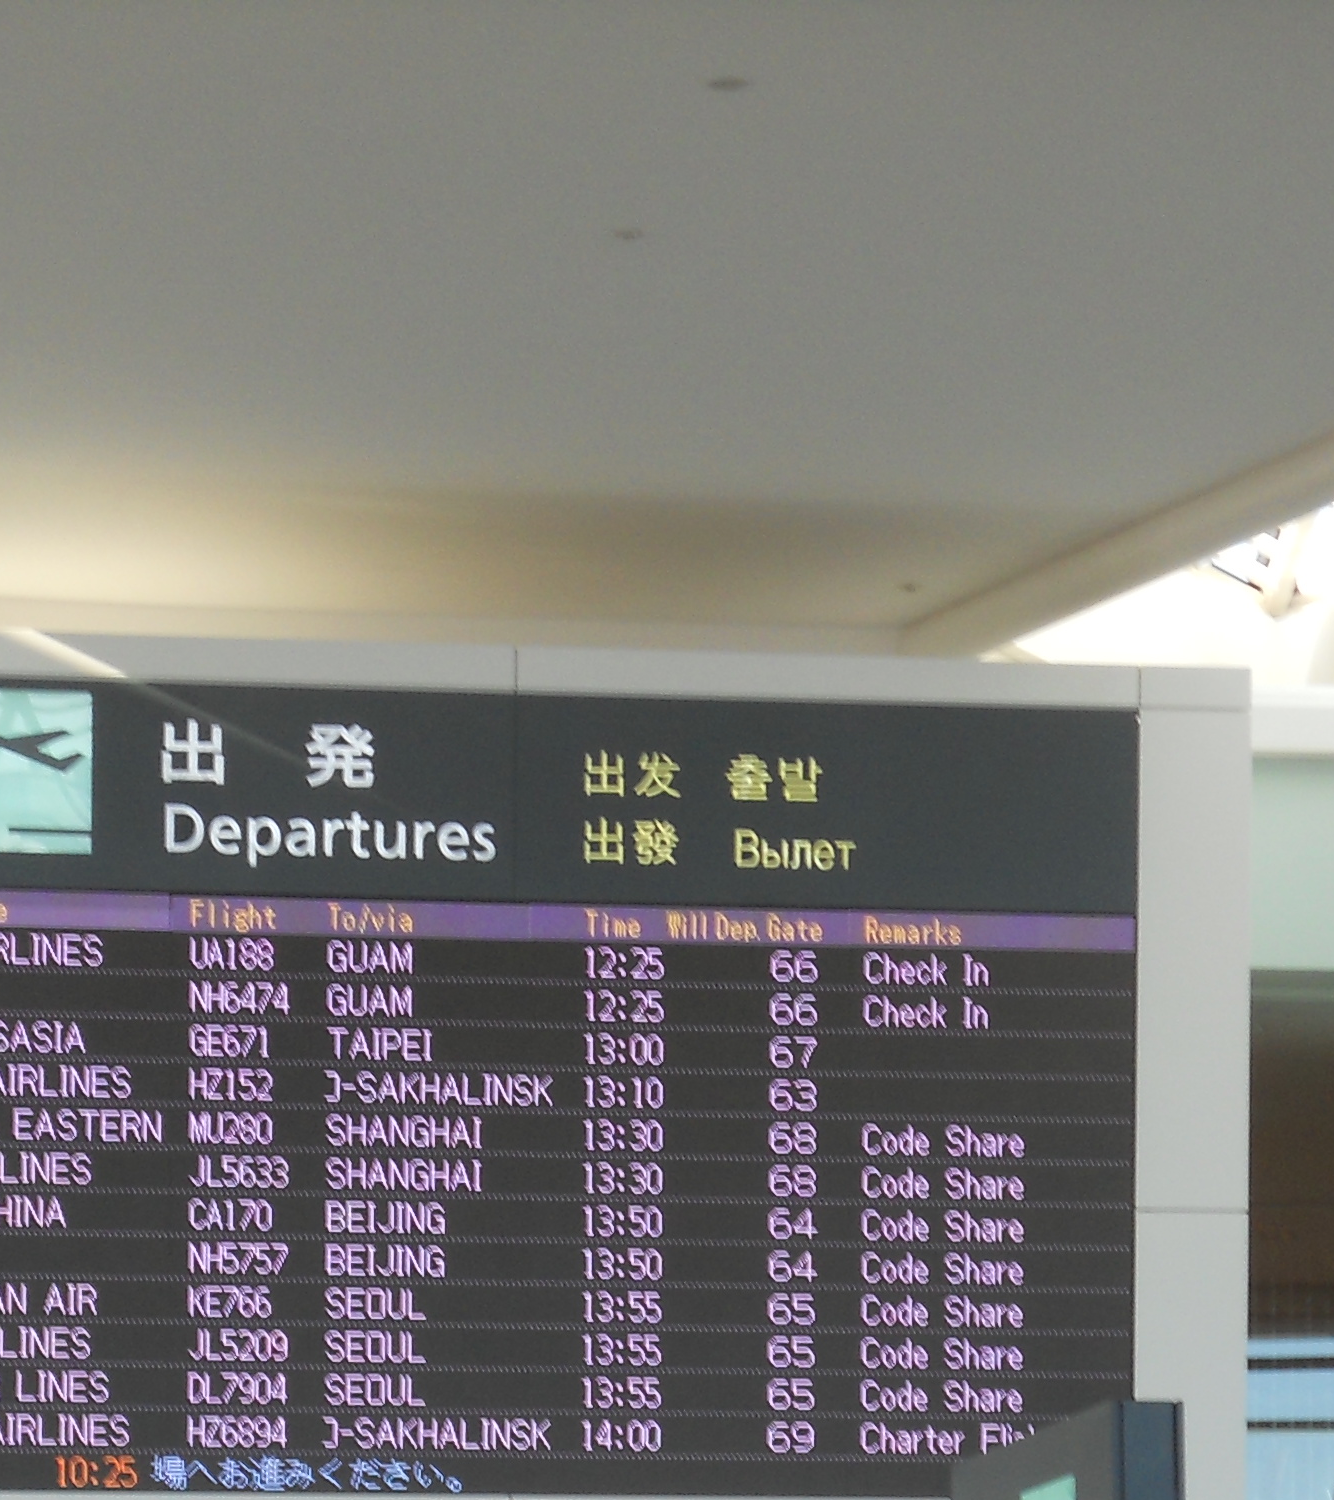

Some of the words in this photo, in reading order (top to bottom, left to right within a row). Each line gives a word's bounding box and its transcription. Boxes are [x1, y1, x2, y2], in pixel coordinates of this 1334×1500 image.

[584, 750, 681, 798] 出发
[725, 753, 823, 802] 출발
[163, 801, 497, 868] Departures
[584, 816, 679, 866] 出發
[734, 828, 857, 871] Вылет
[189, 898, 277, 933] Flight
[583, 908, 641, 940] Time
[767, 914, 824, 944] Gate
[863, 916, 962, 946] Remarks
[325, 939, 414, 974] GUAM
[583, 945, 666, 981] 12:25
[769, 949, 819, 984] 66
[863, 951, 948, 987] Check
[962, 953, 991, 987] In
[188, 979, 290, 1015] NH6474
[325, 983, 414, 1018] GUAM
[583, 989, 666, 1024] 12:25
[769, 992, 819, 1028] 66
[863, 994, 948, 1030] Check
[962, 996, 991, 1030] In
[188, 1022, 269, 1059] GE671
[327, 1026, 433, 1062] TAIPEI
[583, 1032, 665, 1067] 13:00
[768, 1035, 819, 1070] 67
[188, 1066, 274, 1102] HZ152
[583, 1075, 665, 1110] 13:10
[768, 1078, 818, 1113] 63
[12, 1107, 163, 1143] EASTERN
[325, 1113, 482, 1149] SHANGHAI
[582, 1118, 664, 1153] 13:30
[768, 1121, 818, 1156] 68
[861, 1122, 930, 1158] Code
[944, 1123, 1026, 1159] Share
[187, 1154, 289, 1190] JL5633
[325, 1156, 482, 1192] SHANGHAI
[582, 1161, 664, 1196] 13:30
[768, 1164, 818, 1199] 68
[861, 1166, 930, 1201] Code
[944, 1166, 1026, 1202] Share
[187, 1197, 274, 1232] CA170
[325, 1199, 446, 1235] BEIJING
[582, 1204, 664, 1239] 13:50
[767, 1206, 818, 1241] 64
[860, 1208, 930, 1243] Code
[944, 1209, 1025, 1244] Share
[187, 1241, 289, 1275] NH5757
[324, 1243, 446, 1278] BEIJING
[582, 1247, 664, 1281] 13:50
[767, 1249, 818, 1284] 64
[860, 1251, 929, 1286] Code
[944, 1251, 1025, 1287] Share
[43, 1282, 98, 1316] AIR
[187, 1284, 273, 1319] KE766
[324, 1286, 427, 1321] SEOUL
[582, 1290, 664, 1324] 13:55
[767, 1292, 817, 1327] 65
[860, 1293, 929, 1328] Code
[944, 1294, 1025, 1329] Share
[187, 1327, 289, 1362] JL5209
[323, 1329, 427, 1364] SEOUL
[581, 1332, 663, 1367] 13:55
[767, 1335, 817, 1370] 65
[859, 1336, 929, 1371] Code
[943, 1337, 1025, 1372] Share
[16, 1370, 110, 1403] LINES
[186, 1371, 288, 1406] DL7904
[323, 1373, 427, 1408] SEOUL
[581, 1375, 663, 1410] 13:55
[766, 1378, 817, 1412] 65
[859, 1378, 929, 1414] Code
[943, 1379, 1024, 1414] Share
[581, 1418, 663, 1453] 14:00
[766, 1421, 817, 1455] 69
[859, 1421, 966, 1456] Charter
[54, 1455, 140, 1489] 10:25
